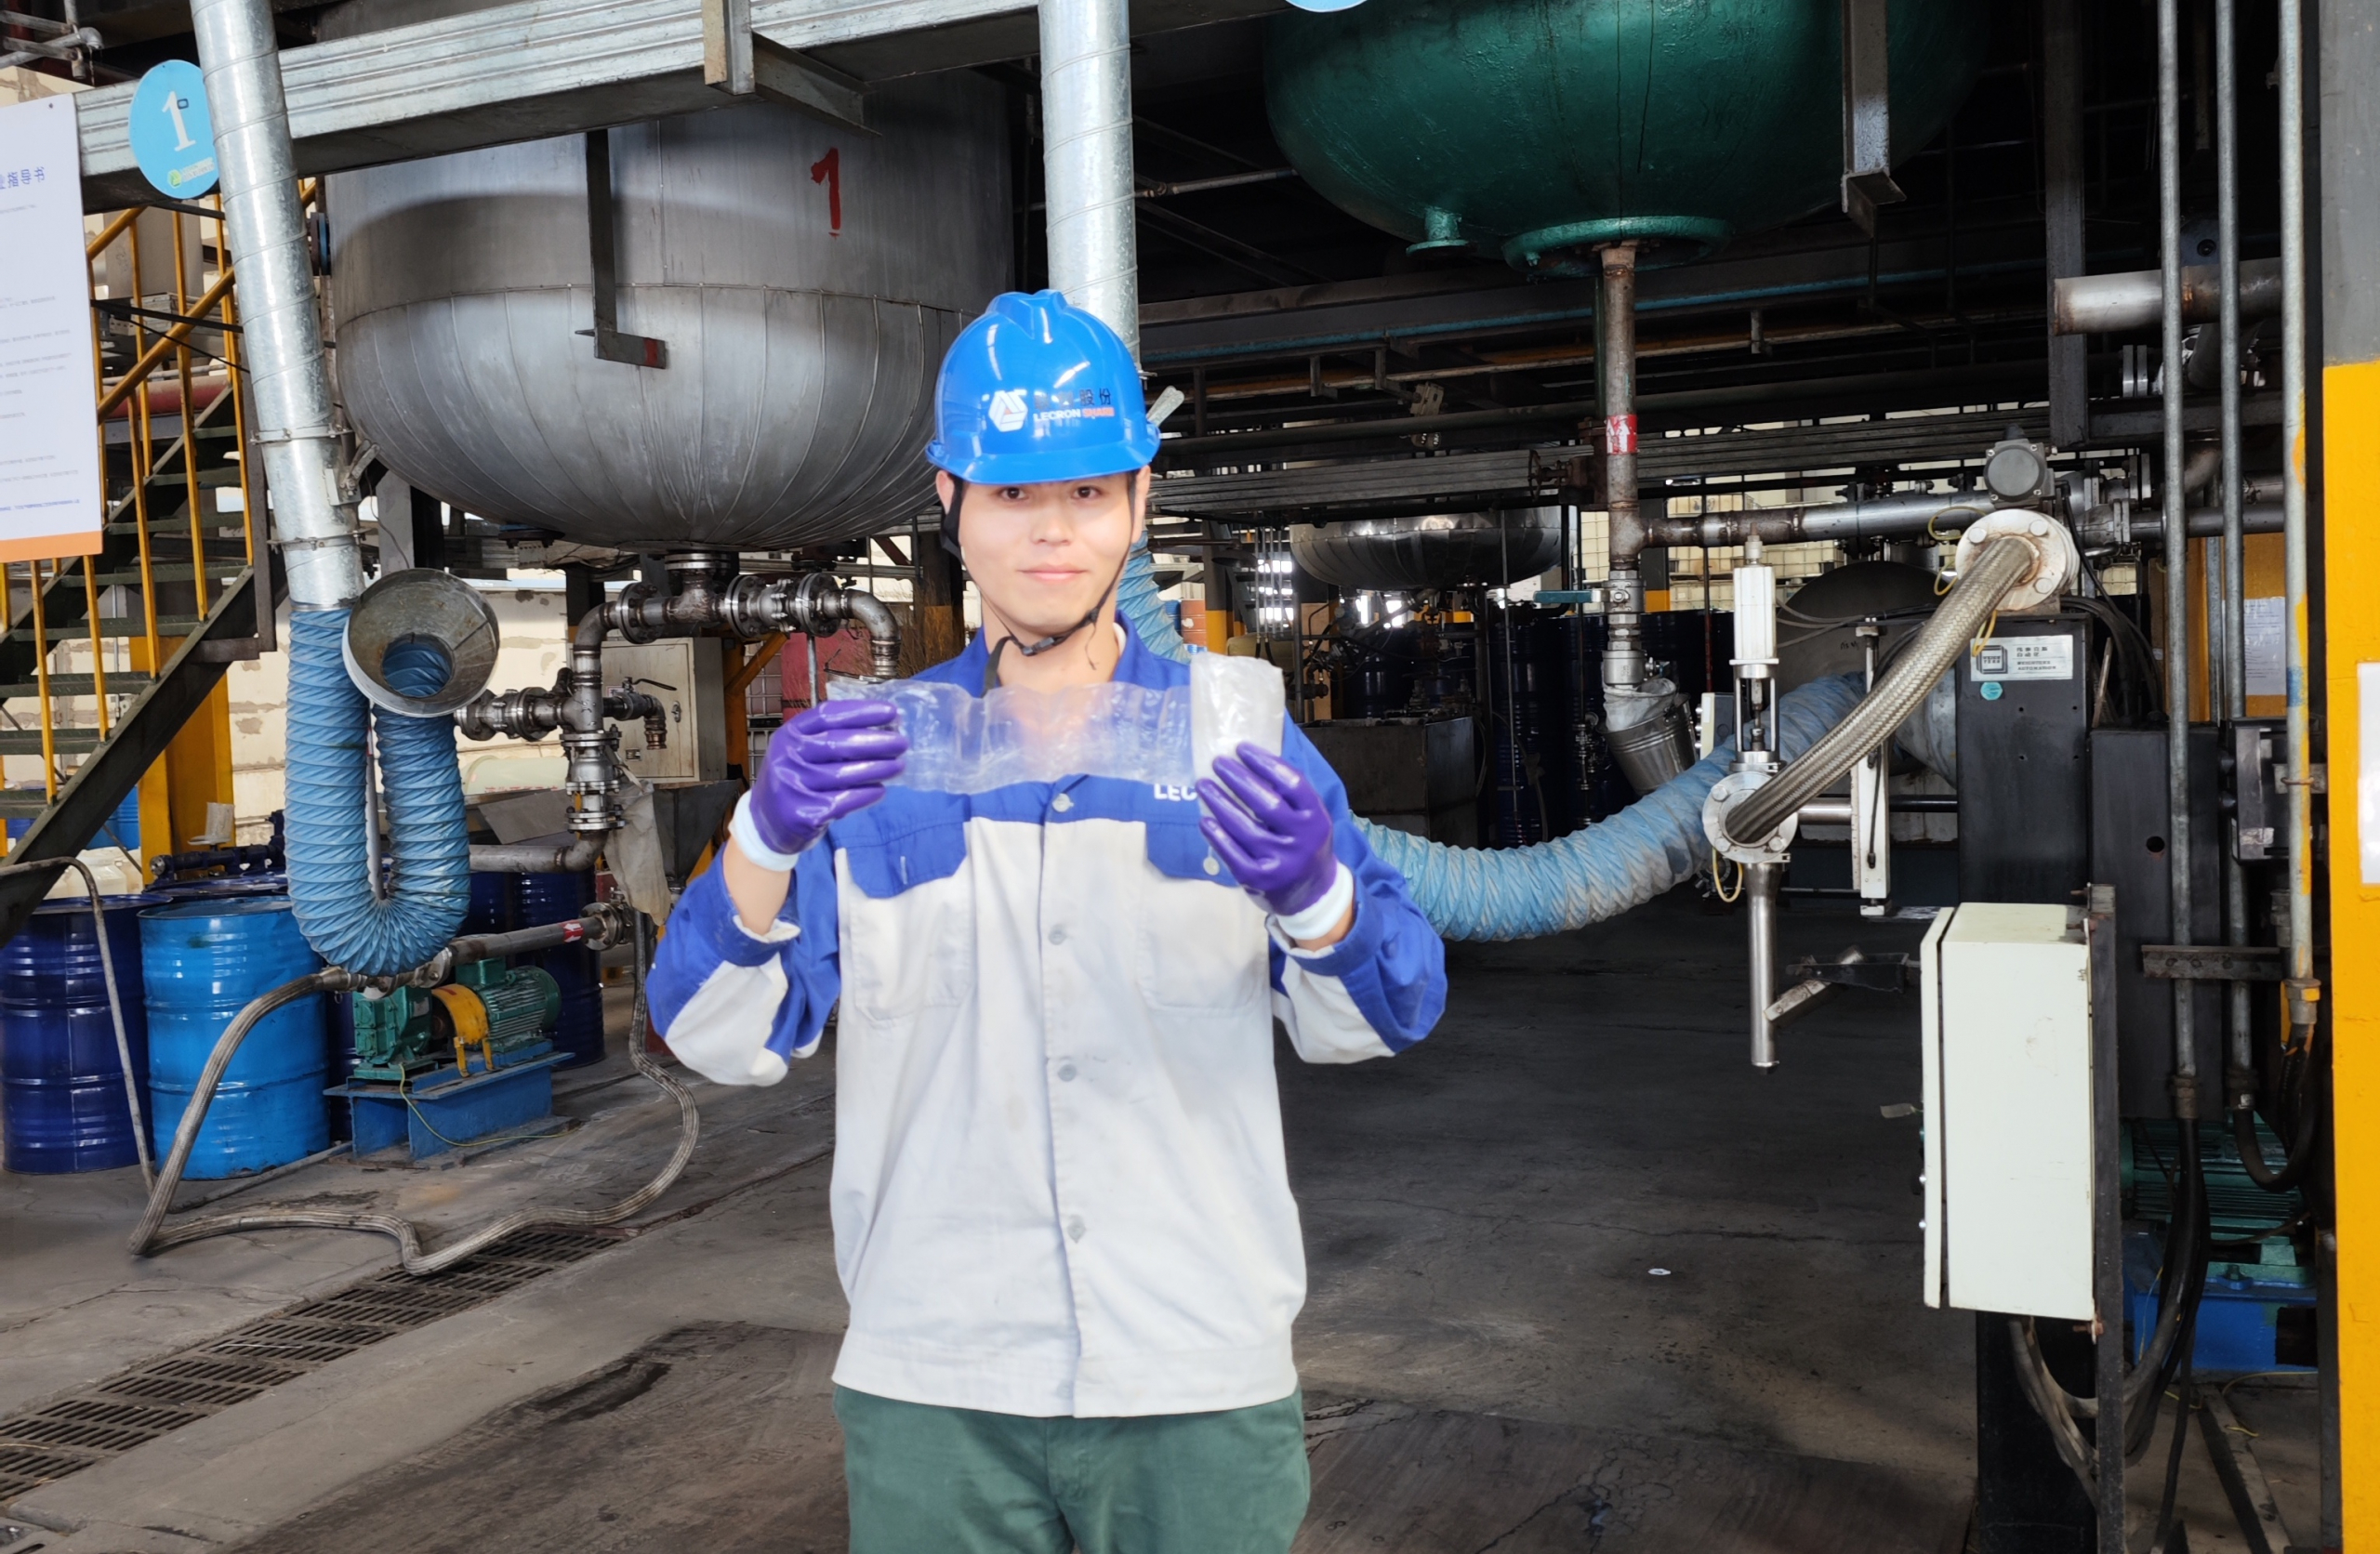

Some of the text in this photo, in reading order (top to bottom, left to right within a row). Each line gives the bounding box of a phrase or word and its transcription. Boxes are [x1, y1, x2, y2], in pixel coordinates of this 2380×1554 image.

[162, 91, 196, 151] 1
[811, 147, 841, 239] 1
[1033, 408, 1081, 421] LECRON
